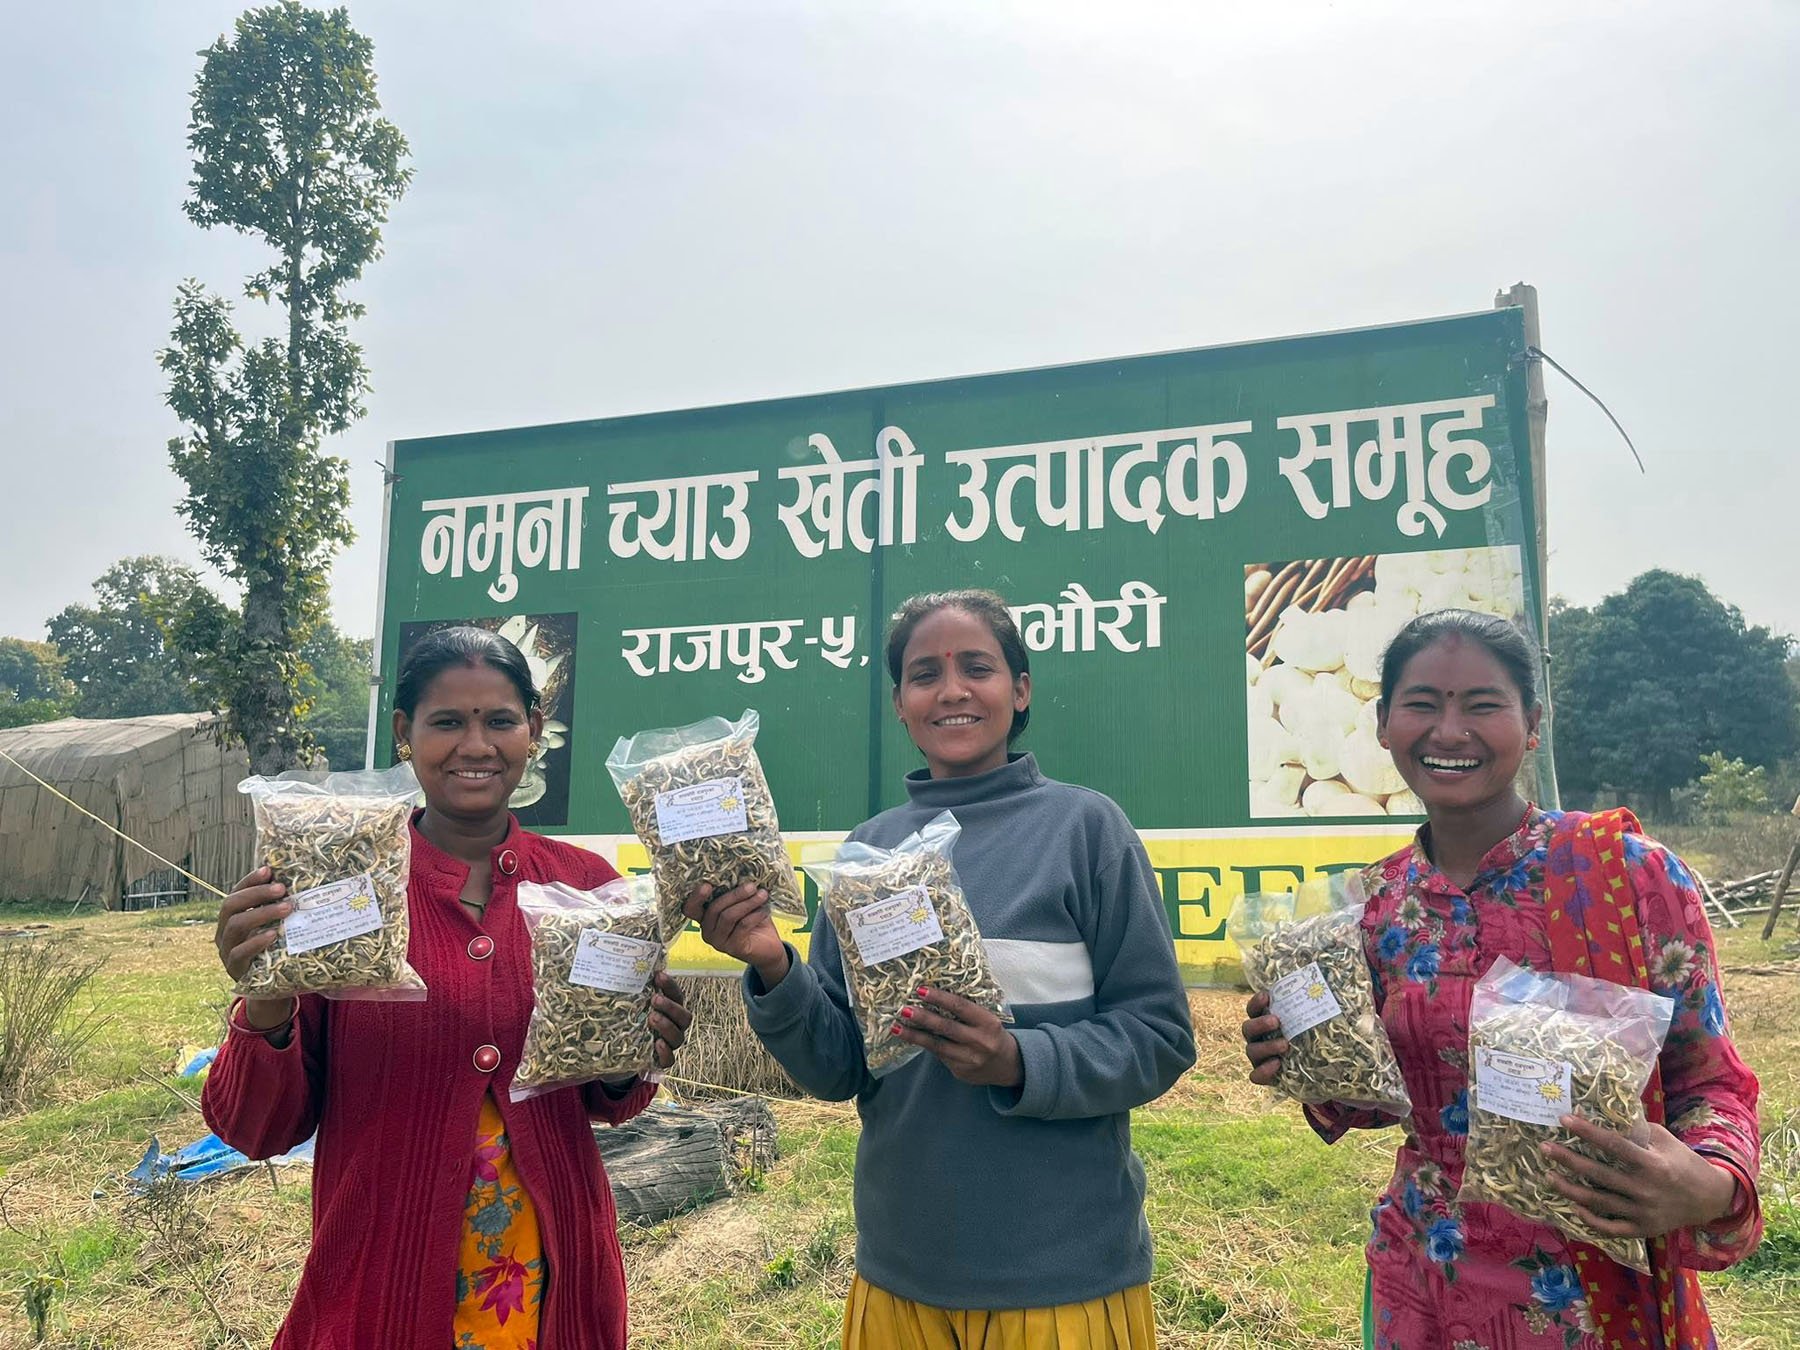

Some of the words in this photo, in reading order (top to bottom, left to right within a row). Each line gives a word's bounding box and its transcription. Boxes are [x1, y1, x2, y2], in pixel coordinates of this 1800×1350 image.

[421, 486, 590, 602] नमुना
[606, 470, 759, 562] च्याउ
[778, 425, 925, 558] खेती
[944, 420, 1252, 543] उत्पादक
[1277, 394, 1496, 539] समूह
